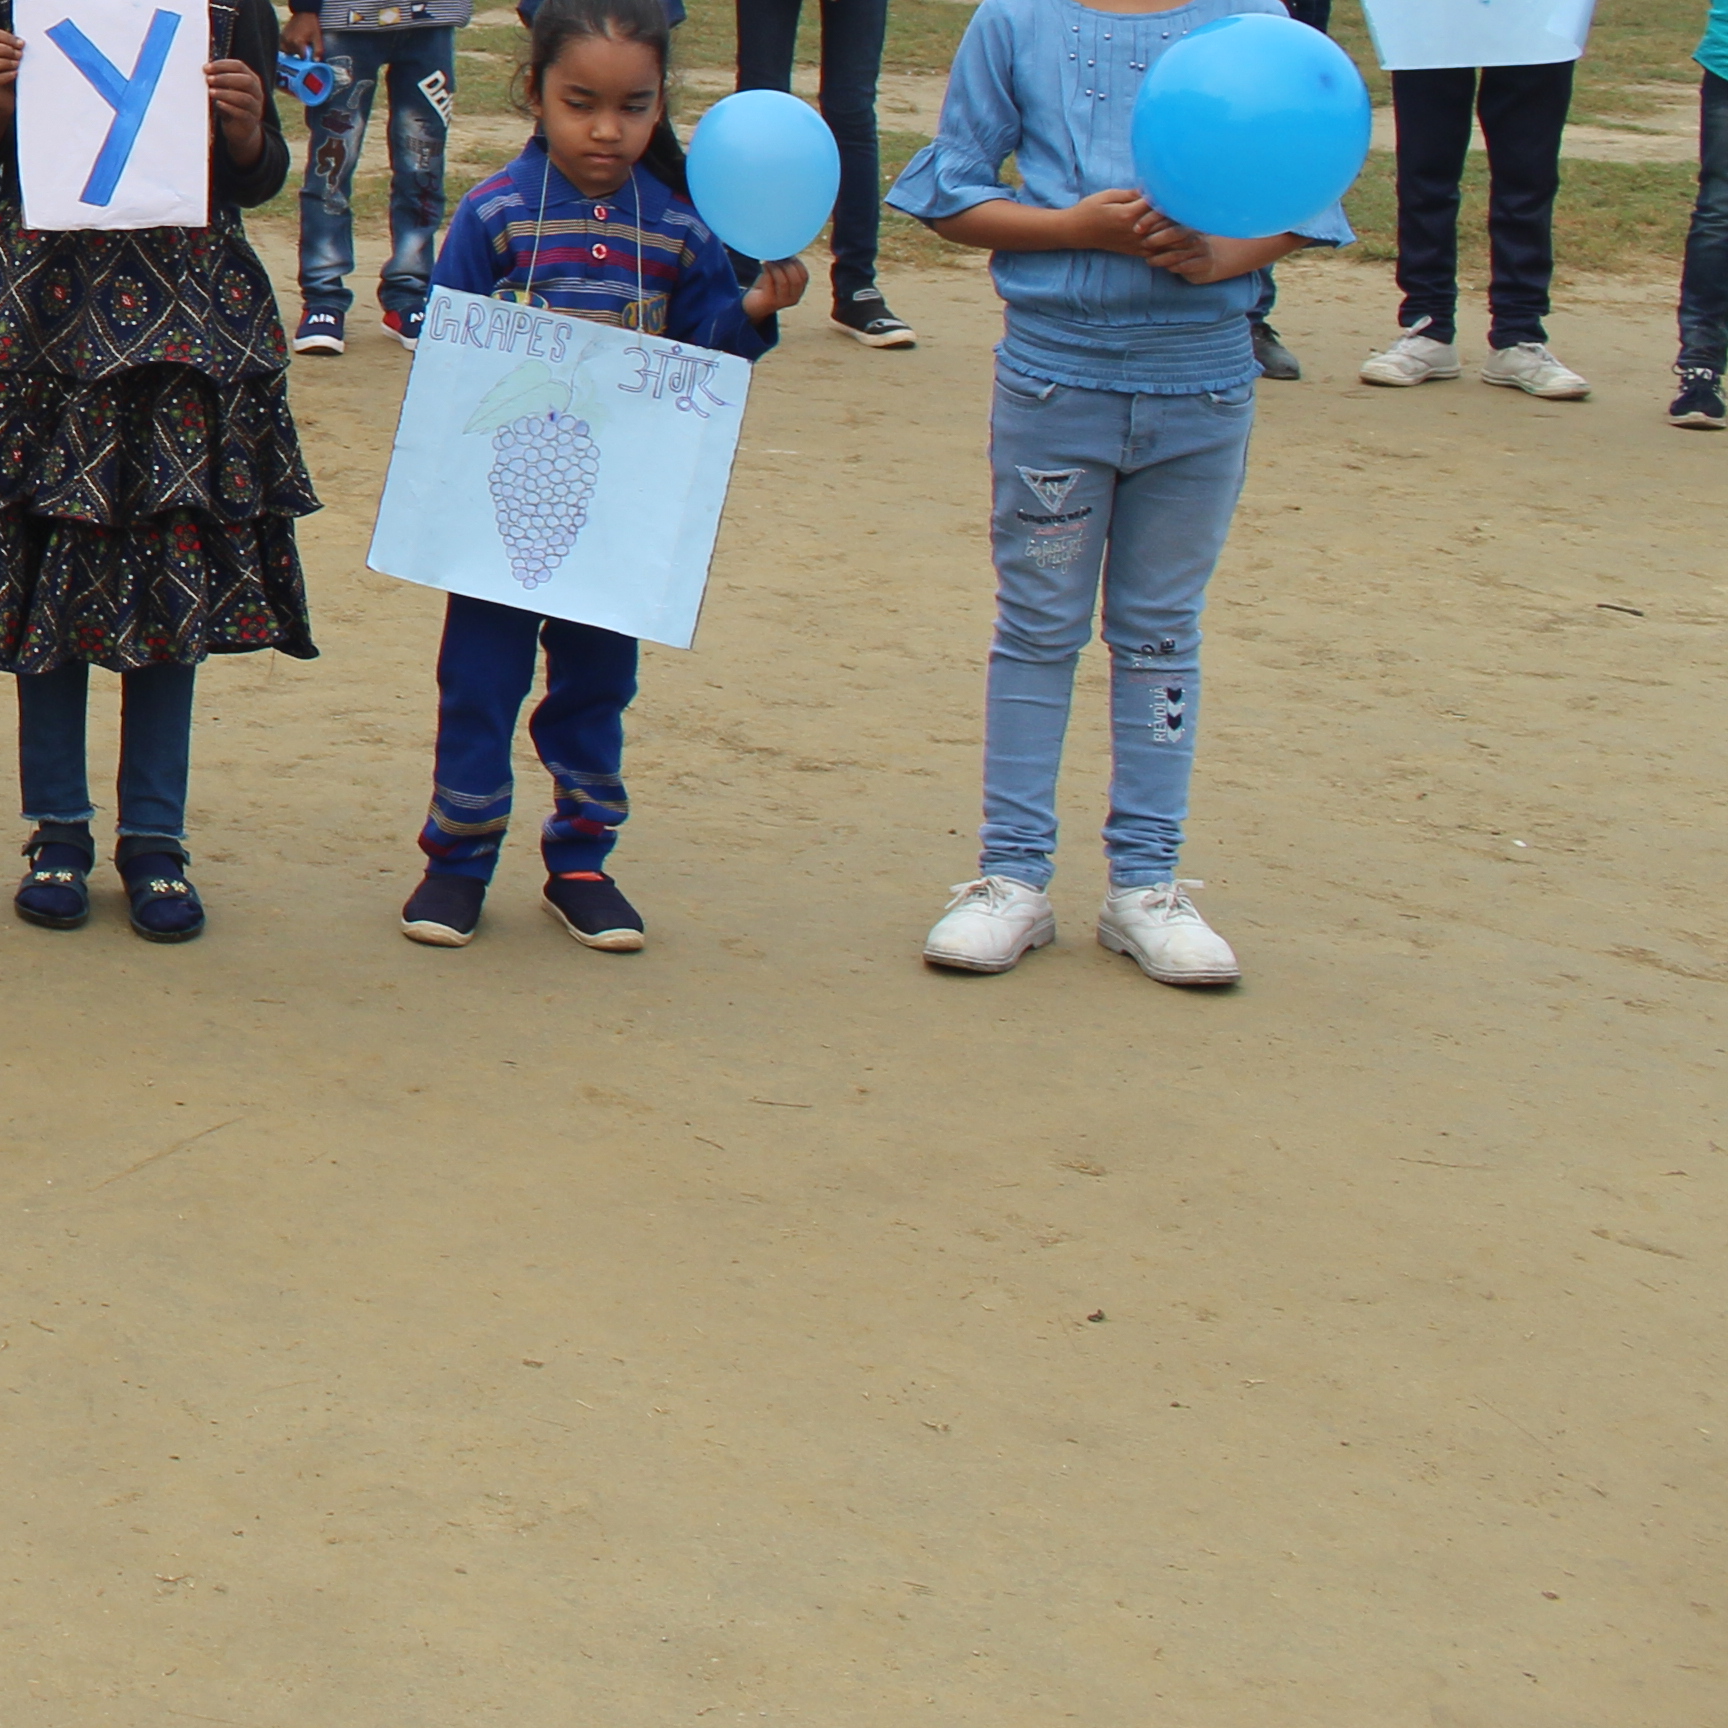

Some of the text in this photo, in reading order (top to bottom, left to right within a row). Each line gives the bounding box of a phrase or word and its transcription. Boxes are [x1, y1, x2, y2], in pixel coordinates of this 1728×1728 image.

[45, 9, 182, 206] Y
[307, 313, 336, 325] AIR
[428, 296, 573, 364] GRAPES
[617, 343, 732, 419] अंगूर
